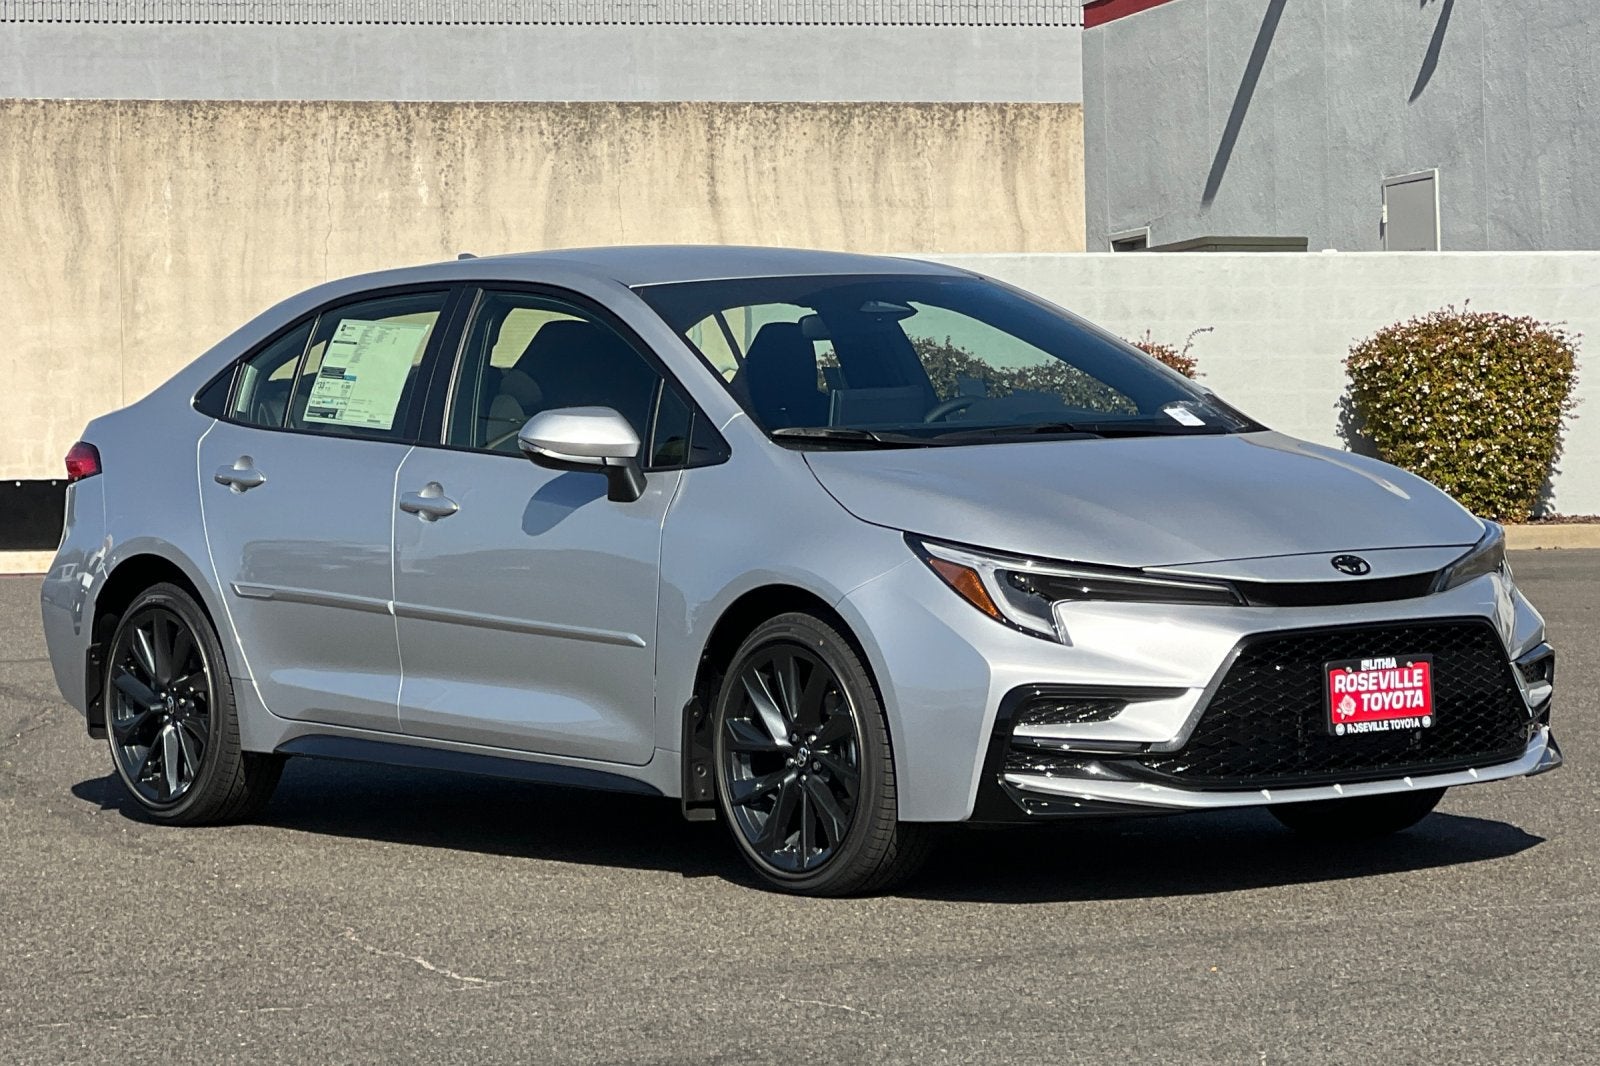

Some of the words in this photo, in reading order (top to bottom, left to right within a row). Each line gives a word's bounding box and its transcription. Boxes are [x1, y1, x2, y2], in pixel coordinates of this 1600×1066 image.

[1370, 657, 1397, 670] LITHIA
[1335, 669, 1423, 693] ROSEVILLE
[1361, 689, 1424, 712] TOYOTA
[1347, 721, 1389, 733] ROSEVILLE
[1391, 718, 1420, 730] TOYOTA
